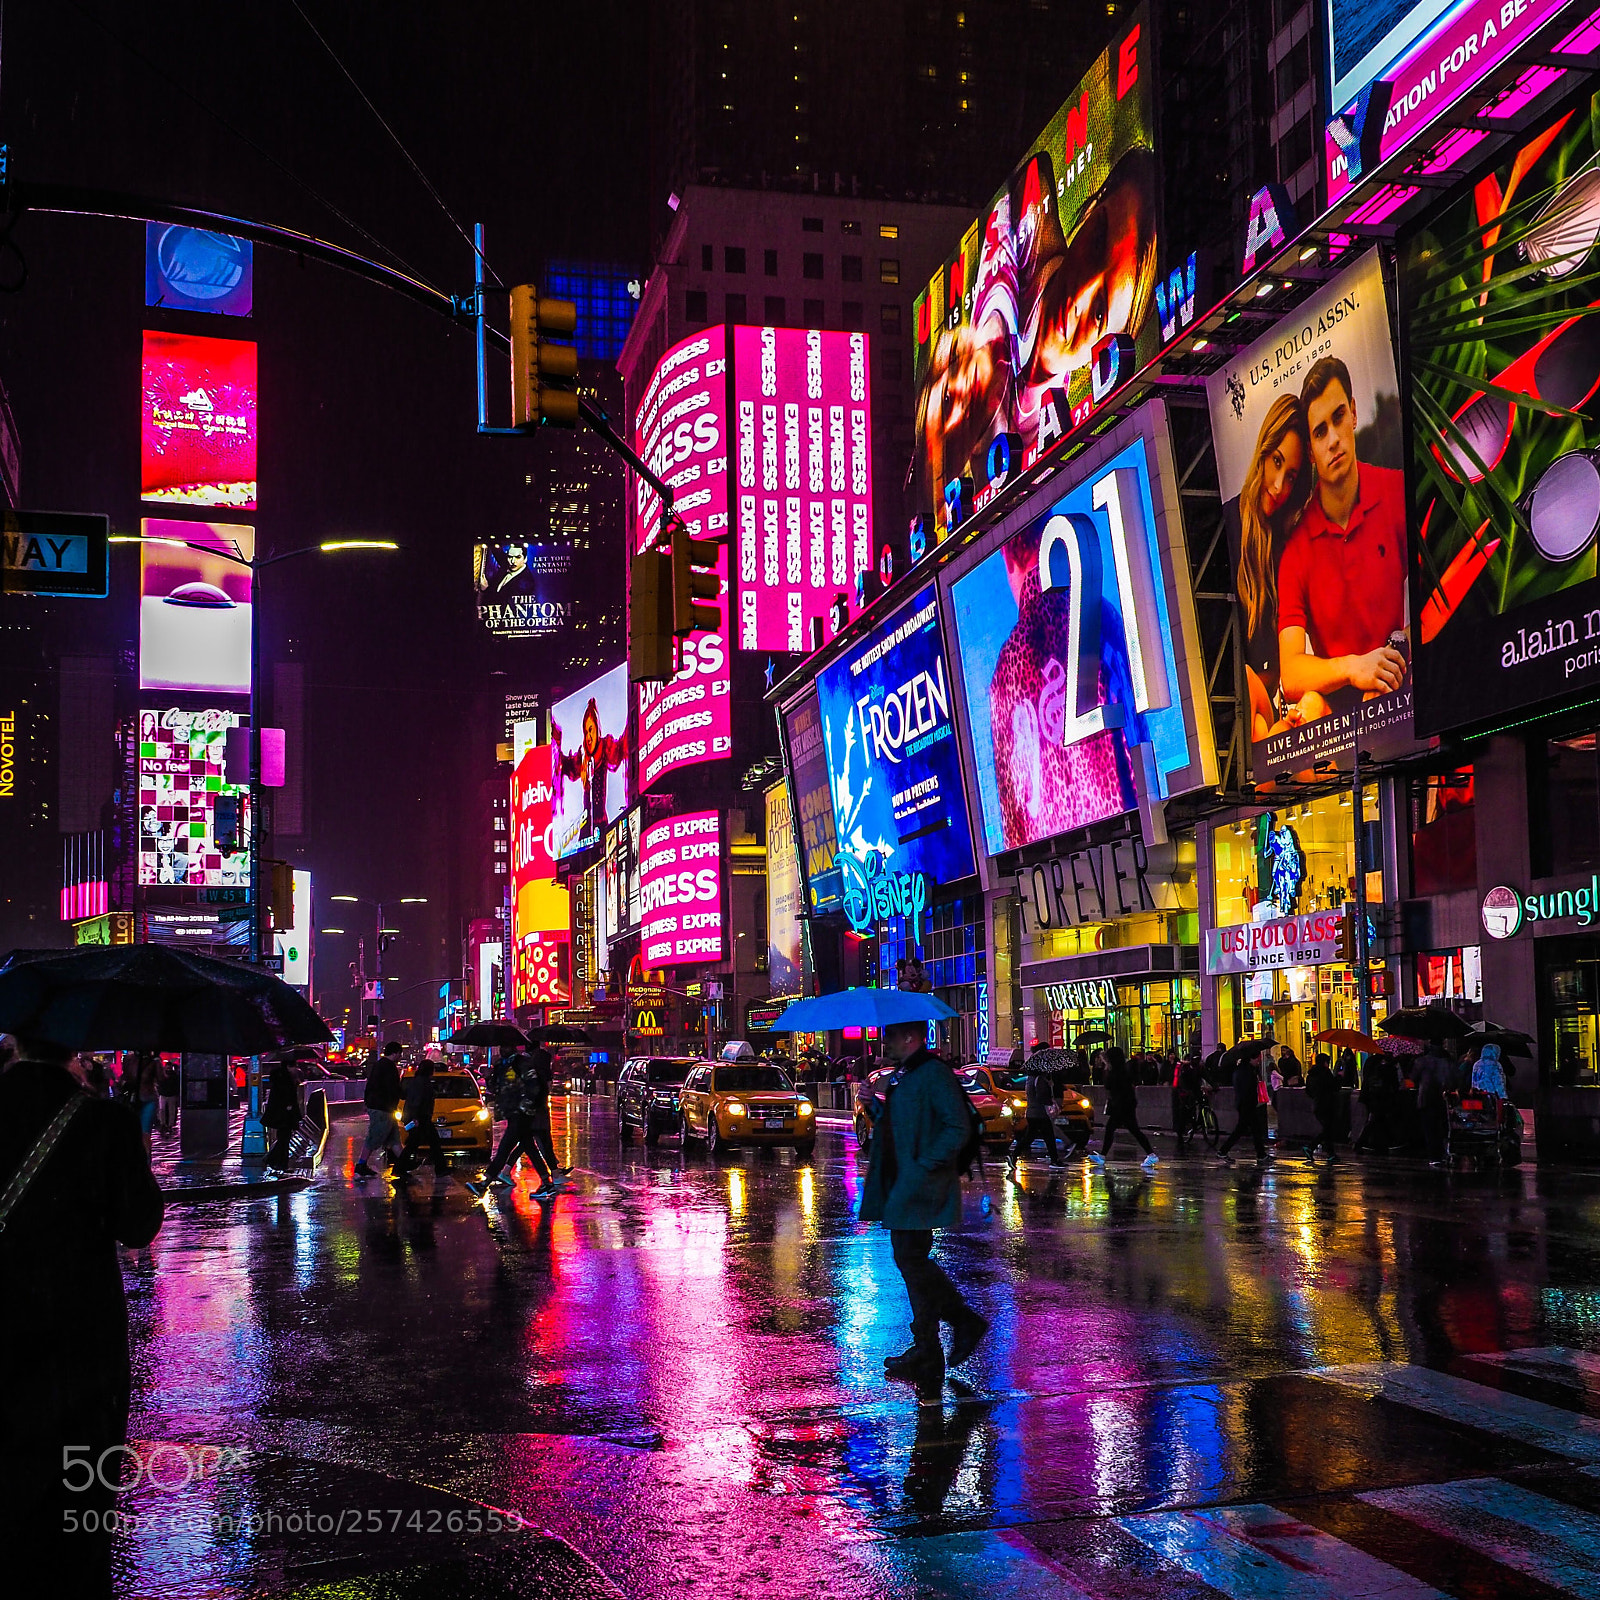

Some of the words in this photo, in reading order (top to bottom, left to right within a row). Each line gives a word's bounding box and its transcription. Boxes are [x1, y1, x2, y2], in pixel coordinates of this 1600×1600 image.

[1440, 35, 1479, 84] FOR
[1481, 19, 1498, 47] A
[918, 23, 1141, 344] UNSANE
[1057, 143, 1093, 197] SHE?
[661, 338, 710, 379] EXPRESS
[1249, 361, 1274, 386] U.S.
[1275, 327, 1313, 369] POLO
[1316, 291, 1361, 338] ASSN.
[1273, 361, 1303, 388] SINCE
[1307, 339, 1332, 363] 1890
[657, 367, 700, 408] EXPRESS
[661, 391, 711, 430] EXPRESS
[739, 400, 755, 488] EXPRESS
[762, 405, 778, 491] EXPRESS
[784, 402, 800, 490] EXPRESS
[808, 407, 824, 494] EXPRESS
[830, 405, 845, 491] EXPRESS
[851, 409, 867, 495] EXPRESS
[740, 495, 757, 583] EXPRESS
[763, 499, 779, 587] EXPRESS
[786, 497, 801, 584] EXPRESS
[809, 501, 825, 588] EXPRESS
[831, 498, 847, 586] EXPRESS
[477, 602, 572, 619] PHANTOM
[485, 620, 500, 628] OF
[502, 619, 526, 628] THE
[526, 617, 564, 627] OPERA
[512, 595, 536, 603] THE
[1039, 469, 1150, 747] 21
[1502, 618, 1579, 669] alain
[510, 709, 530, 718] berry
[523, 692, 539, 701] your
[523, 700, 539, 708] buds
[662, 684, 706, 714] EXPRESS
[857, 655, 949, 764] FROZEN
[664, 711, 713, 739] EXPRESS
[1267, 735, 1292, 755] LIVE
[1298, 693, 1412, 744] AUTHENICALLY
[1267, 756, 1286, 766] PAMELA
[1287, 744, 1315, 760] FLANAGAN
[1369, 719, 1386, 732] POLO
[0, 710, 15, 796] NOVOTEL
[142, 760, 162, 771] No
[662, 740, 706, 766] EXPRESS
[801, 783, 832, 822] COME
[673, 816, 719, 838] EXPRE
[681, 842, 719, 861] EXPR
[209, 890, 218, 901] W
[223, 890, 235, 901] 45
[641, 868, 718, 915] EXPRESS
[1015, 834, 1157, 935] FOREVER
[575, 883, 588, 980] PALACE
[682, 912, 720, 930] EXPR
[1220, 929, 1248, 954] U.S.
[1251, 922, 1298, 950] POLO
[676, 937, 721, 955] EXPRE
[1248, 952, 1285, 966] SINCE
[1289, 949, 1321, 962] 1890
[1045, 979, 1101, 1012] FOREVER
[1102, 978, 1118, 1006] 21
